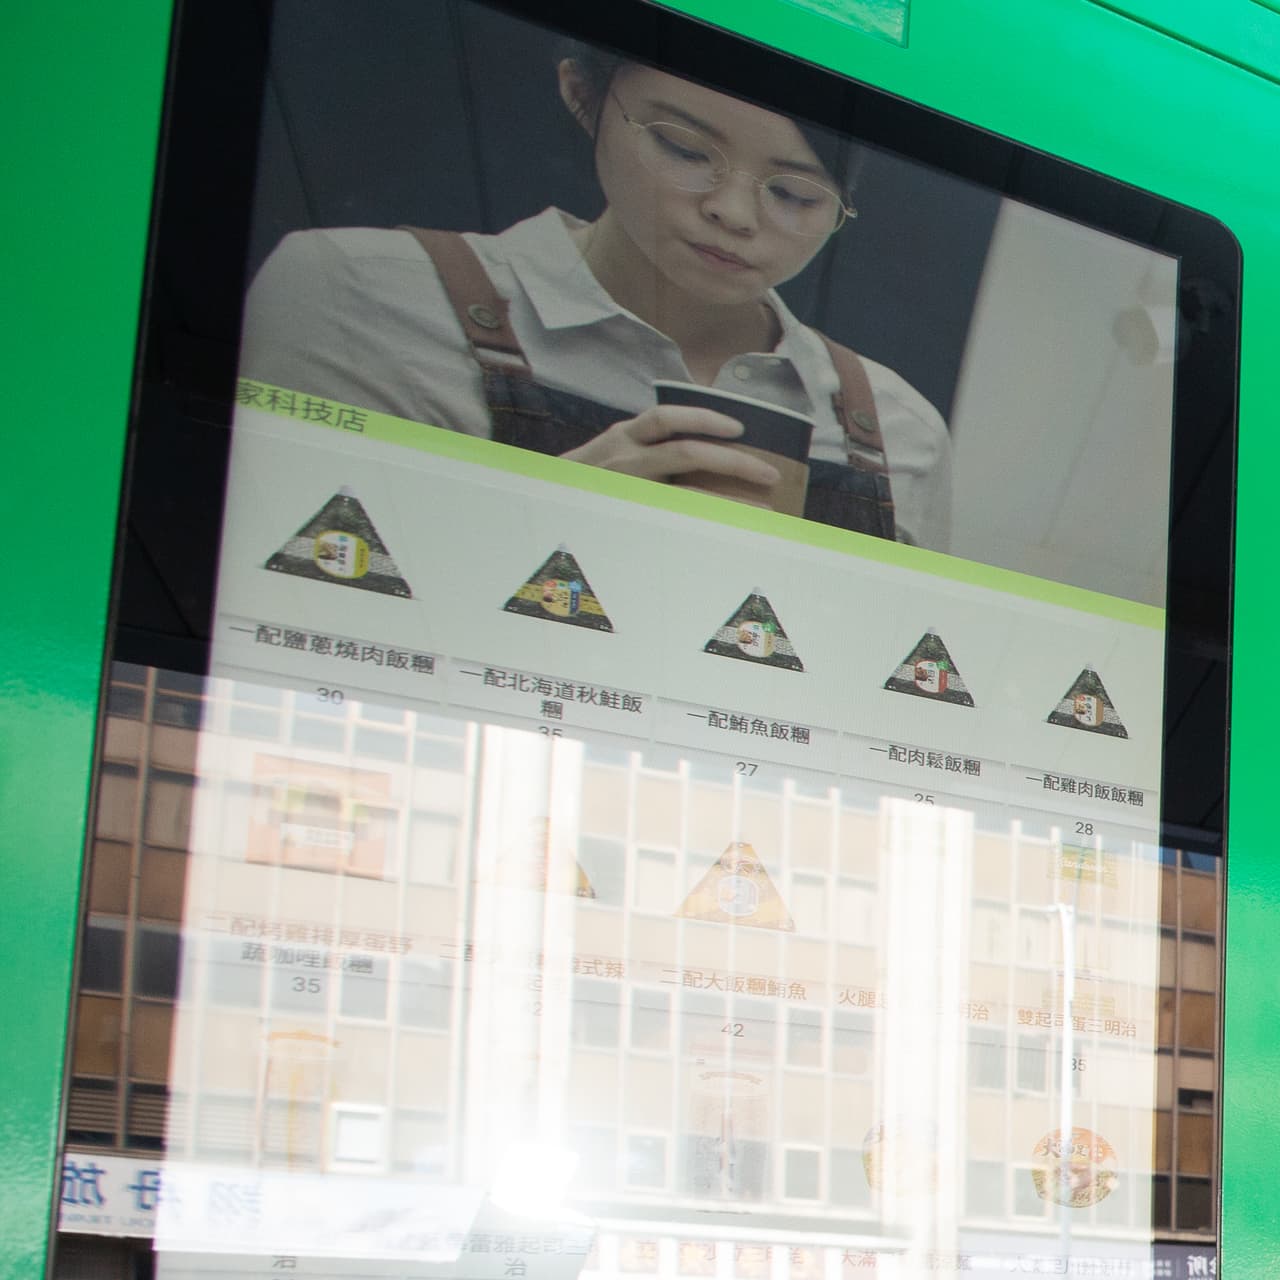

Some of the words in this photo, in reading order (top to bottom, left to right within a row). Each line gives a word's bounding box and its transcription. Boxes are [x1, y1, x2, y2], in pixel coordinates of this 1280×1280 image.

[316, 688, 344, 706] 30
[736, 762, 758, 777] 27
[1075, 822, 1094, 835] 28
[292, 976, 321, 994] 35
[721, 1023, 745, 1038] 42
